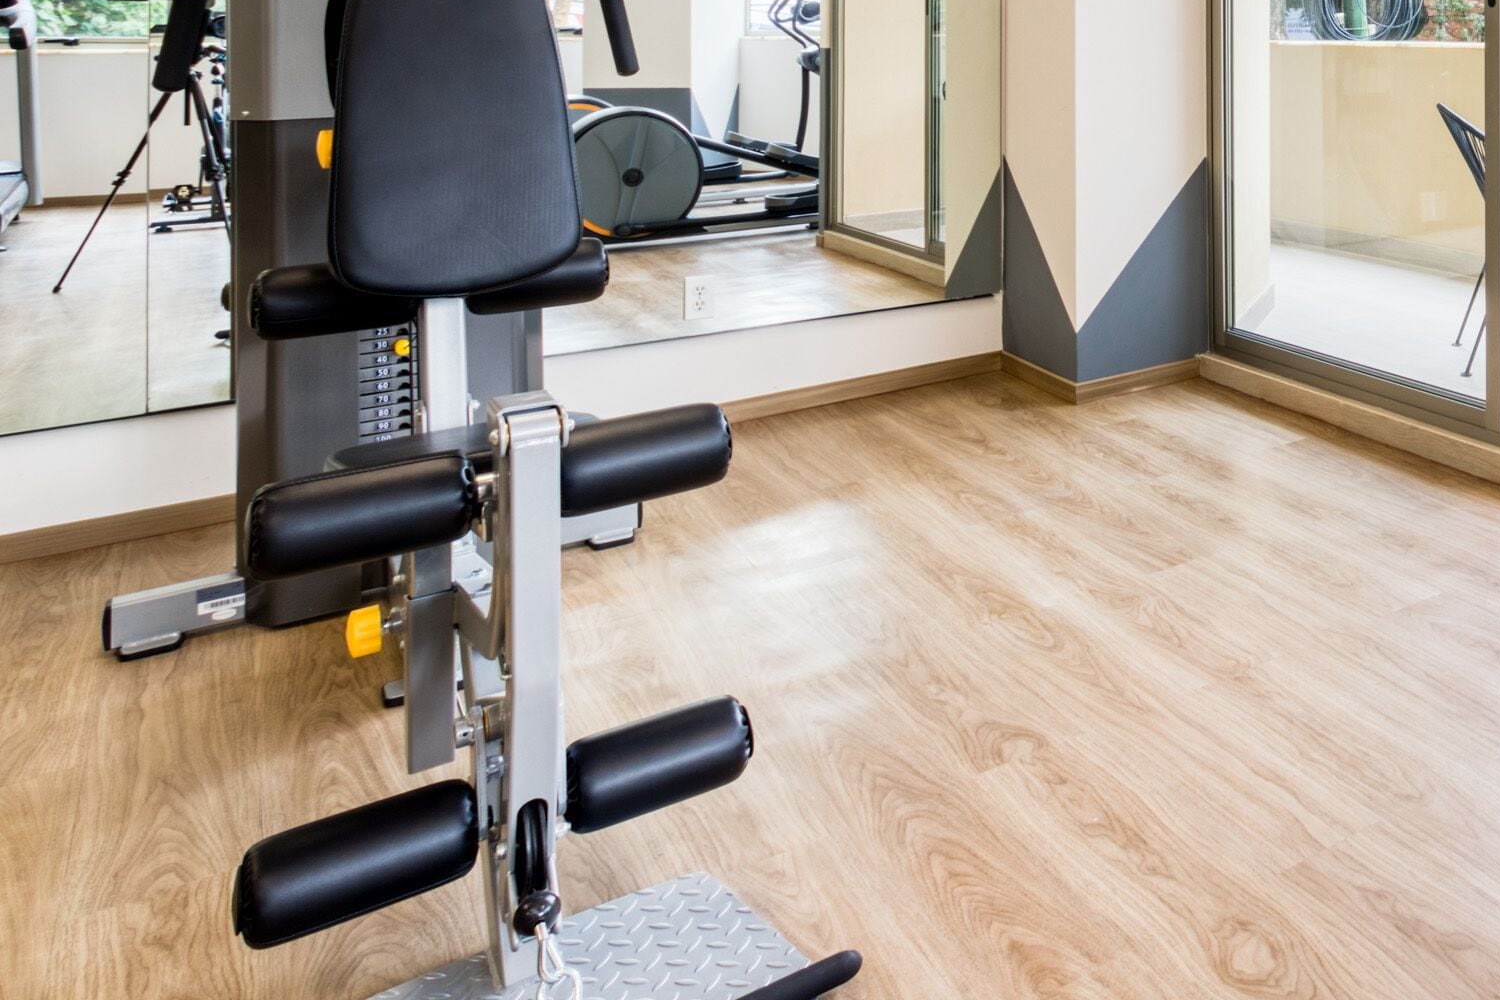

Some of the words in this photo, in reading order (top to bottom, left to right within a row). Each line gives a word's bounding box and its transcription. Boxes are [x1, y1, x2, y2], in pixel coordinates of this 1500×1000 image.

[377, 327, 388, 336] 25
[377, 341, 388, 349] 30
[376, 355, 388, 364] 40
[378, 368, 389, 377] 50
[378, 382, 389, 390] 60
[378, 395, 389, 403] 70
[378, 408, 389, 417] 80
[378, 422, 389, 430] 90
